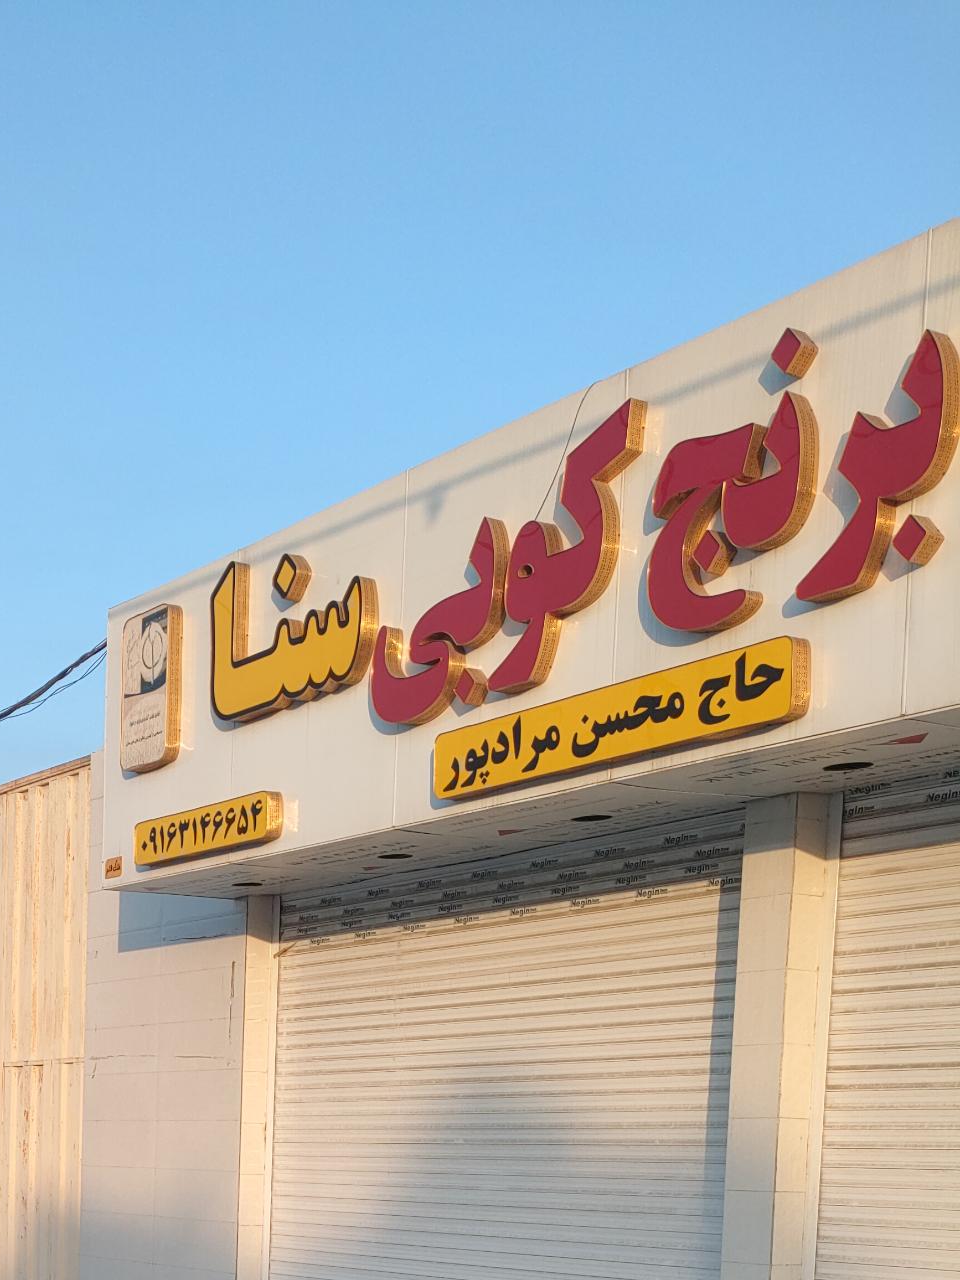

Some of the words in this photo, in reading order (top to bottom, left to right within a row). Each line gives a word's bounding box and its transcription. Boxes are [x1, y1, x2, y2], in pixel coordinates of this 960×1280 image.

[647, 328, 959, 631] برنج
[371, 397, 647, 726] کوبی
[210, 553, 378, 723] سنا
[571, 691, 685, 758] محسن
[698, 653, 784, 725] حاج
[443, 715, 560, 792] مرادپور
[141, 799, 263, 854] ۰۹۱۶۳۱۴۶۶۵۴
